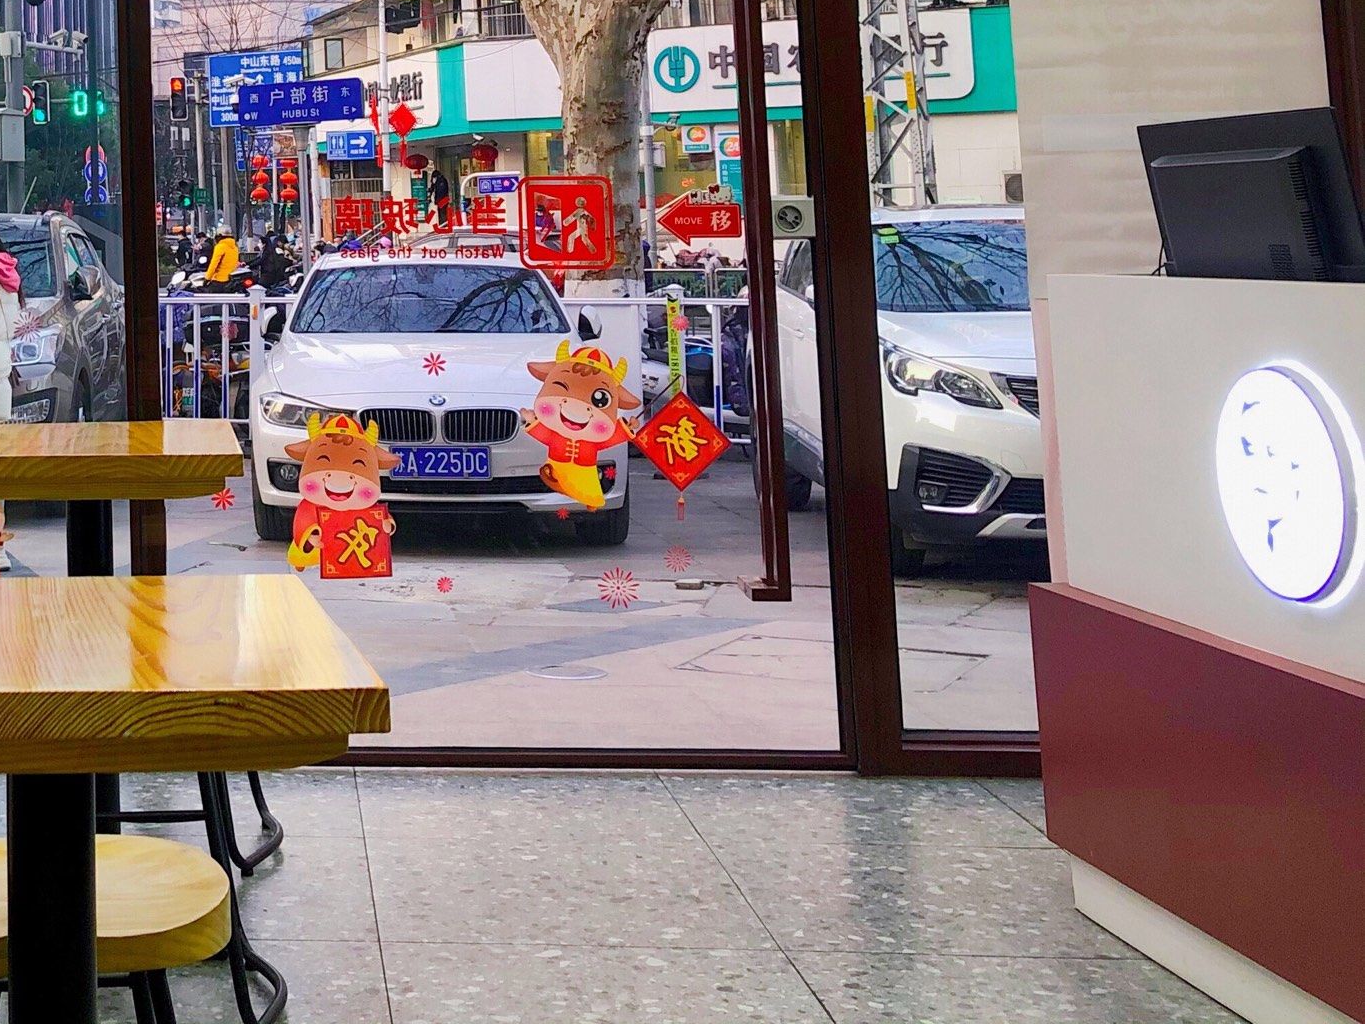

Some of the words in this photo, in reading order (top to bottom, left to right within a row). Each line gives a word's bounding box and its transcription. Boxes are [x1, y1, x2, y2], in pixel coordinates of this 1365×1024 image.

[240, 55, 281, 69] 中山东路
[273, 71, 303, 84] 淮海
[249, 93, 260, 104] 西
[268, 85, 330, 107] 户部街
[340, 86, 351, 98] 东
[250, 111, 259, 121] W
[281, 109, 308, 119] HUBU
[310, 108, 320, 117] St
[342, 106, 349, 115] E
[674, 216, 703, 225] MOVE
[710, 209, 731, 231] 移
